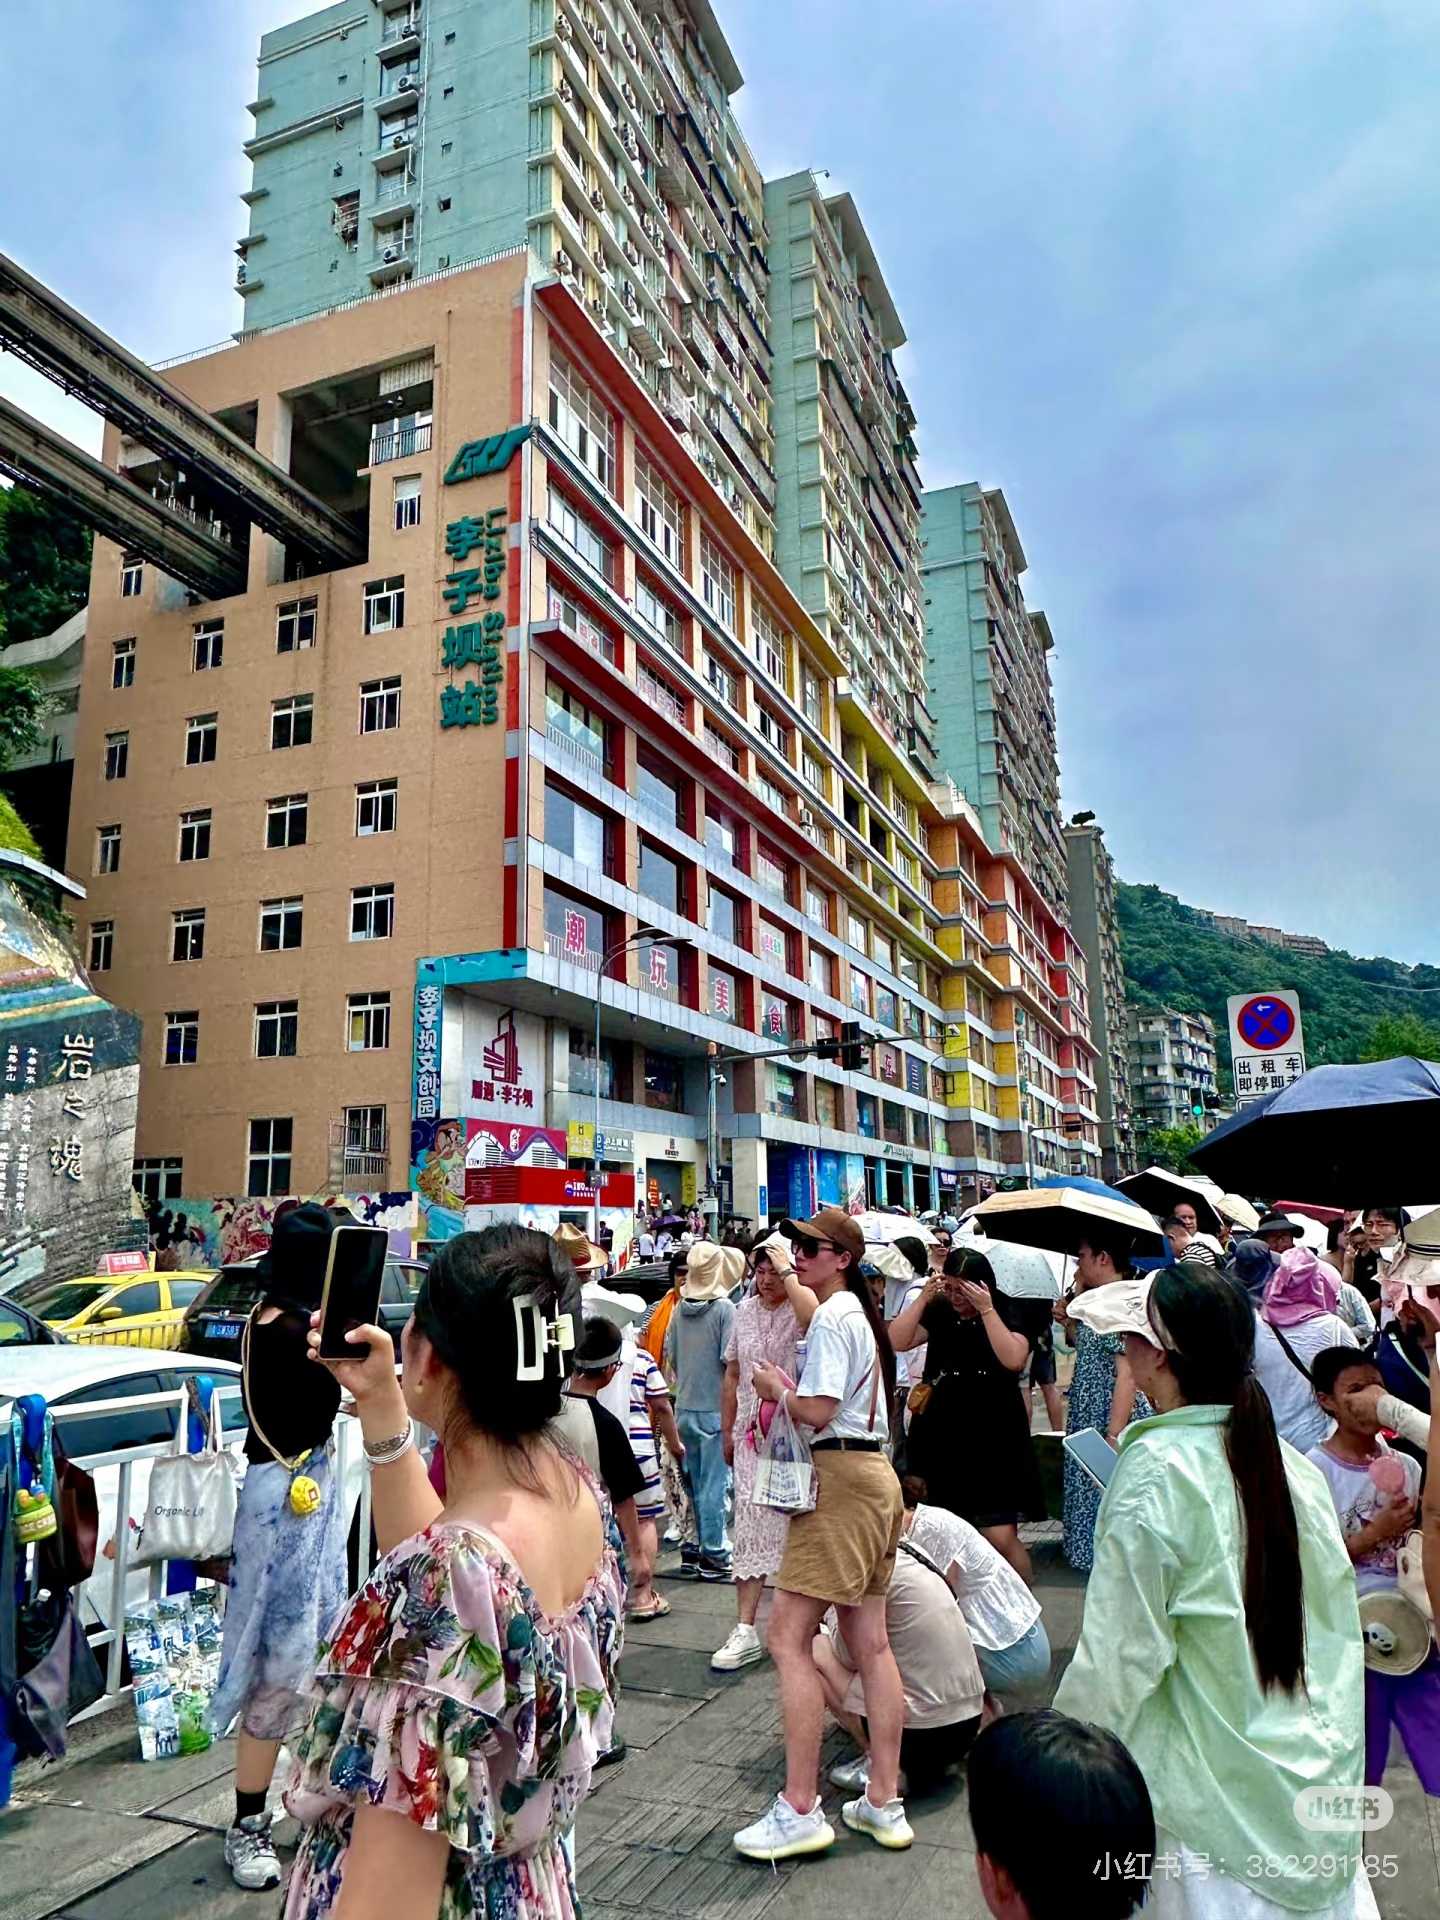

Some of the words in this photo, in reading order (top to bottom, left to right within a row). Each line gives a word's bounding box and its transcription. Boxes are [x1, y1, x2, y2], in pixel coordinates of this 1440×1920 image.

[441, 515, 484, 730] 李子坝站
[564, 909, 588, 957] 潮
[649, 948, 669, 990] 玩
[417, 984, 441, 1119] 李子坝文创园
[1238, 1057, 1300, 1075] 出租车
